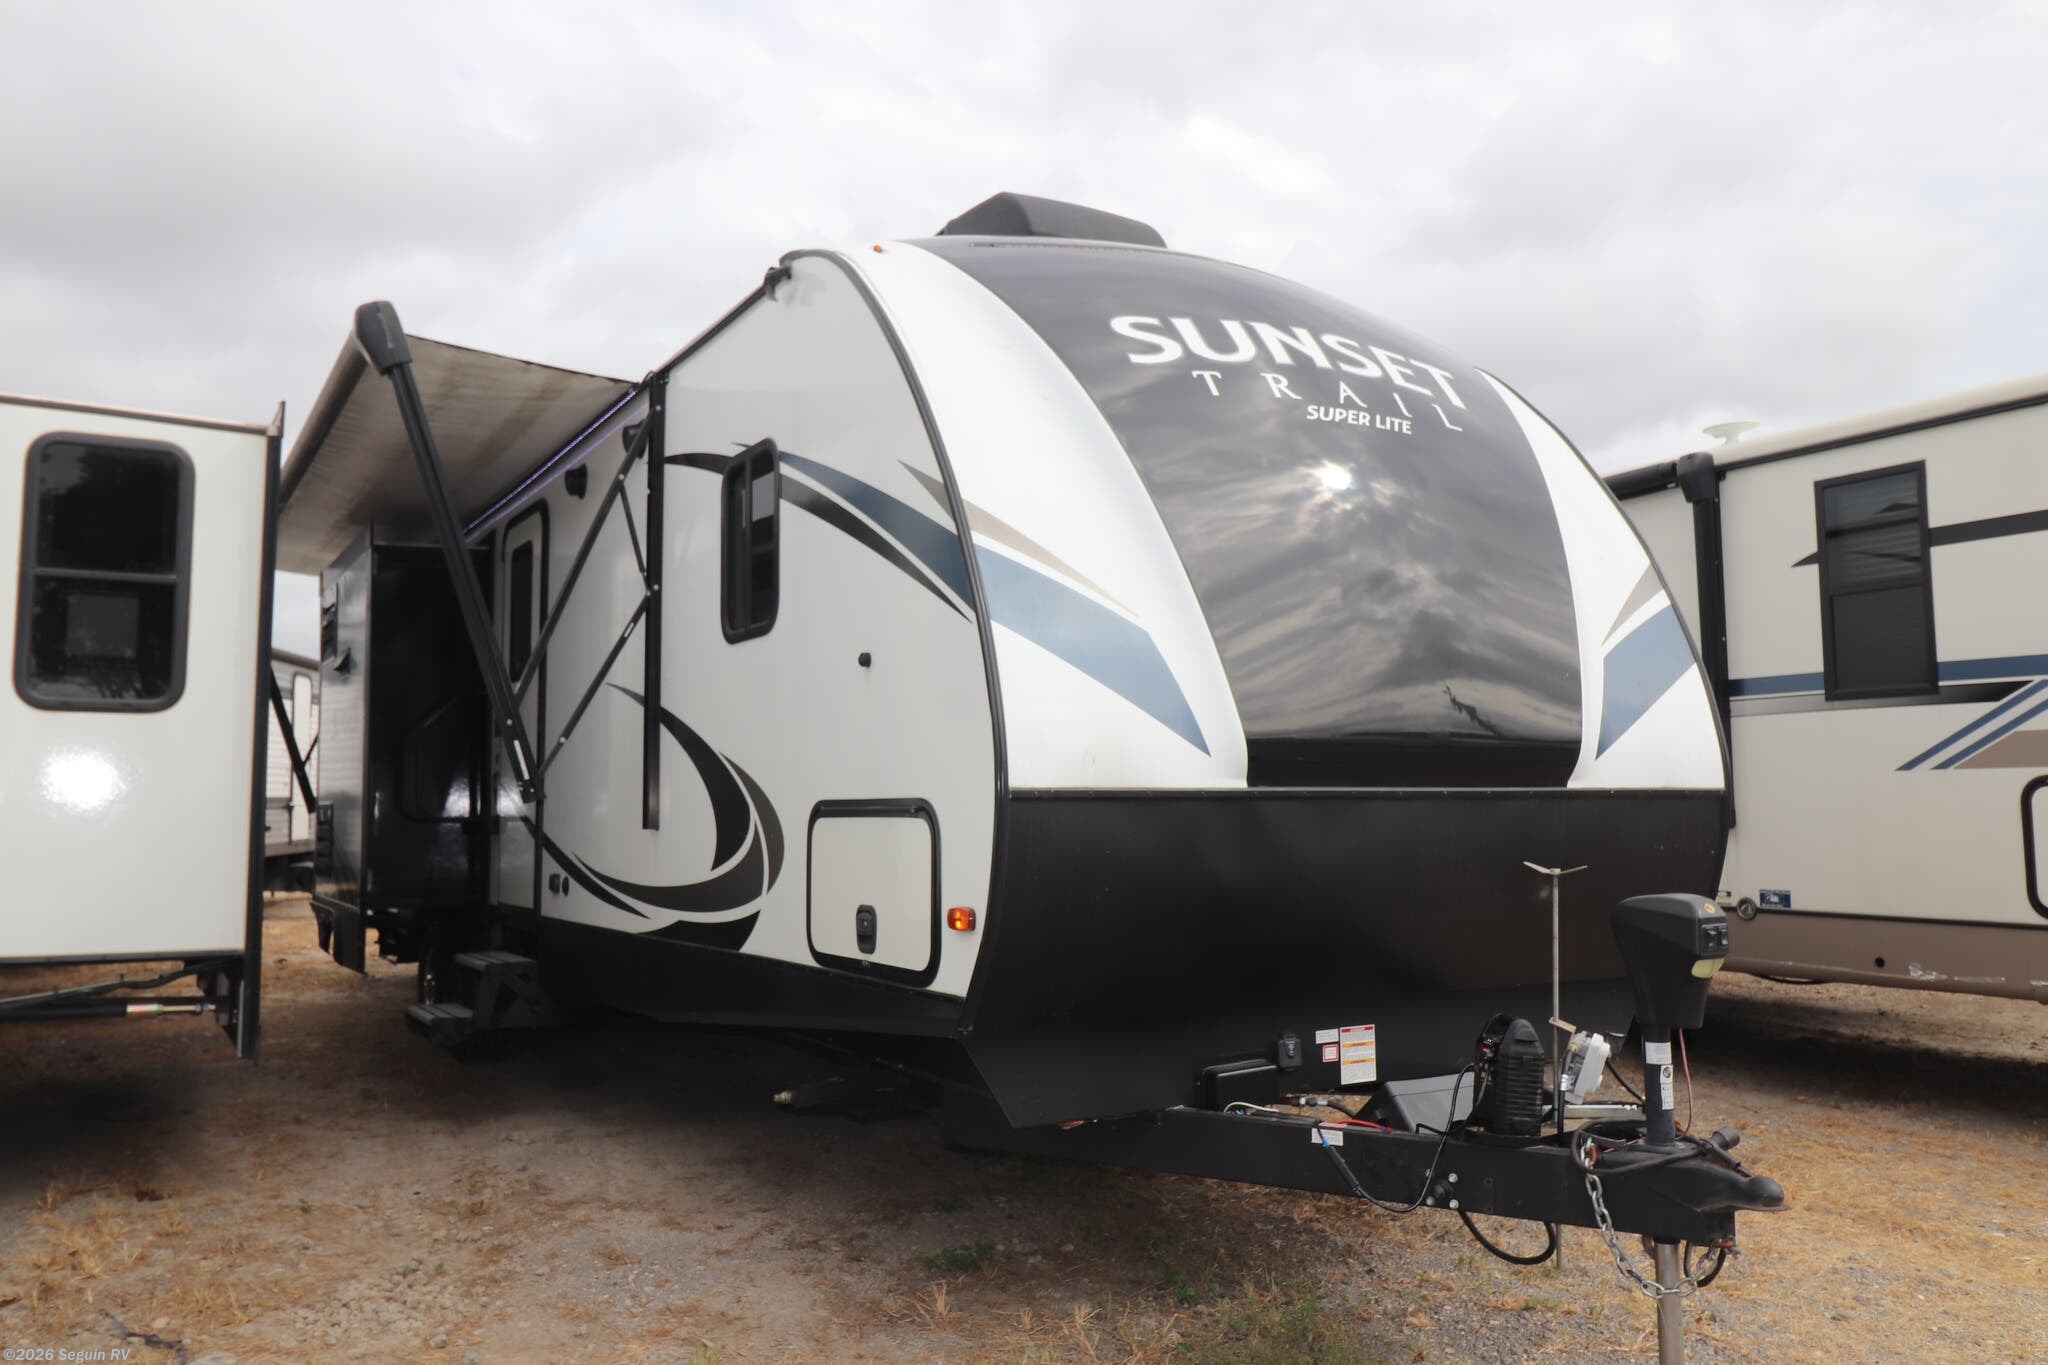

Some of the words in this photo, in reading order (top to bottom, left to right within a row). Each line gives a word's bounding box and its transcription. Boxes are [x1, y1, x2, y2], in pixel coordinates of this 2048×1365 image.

[1109, 315, 1467, 411] SUNSET
[1191, 370, 1464, 432] TRAIL
[1306, 404, 1371, 427] SUPER
[1375, 413, 1413, 435] LITE
